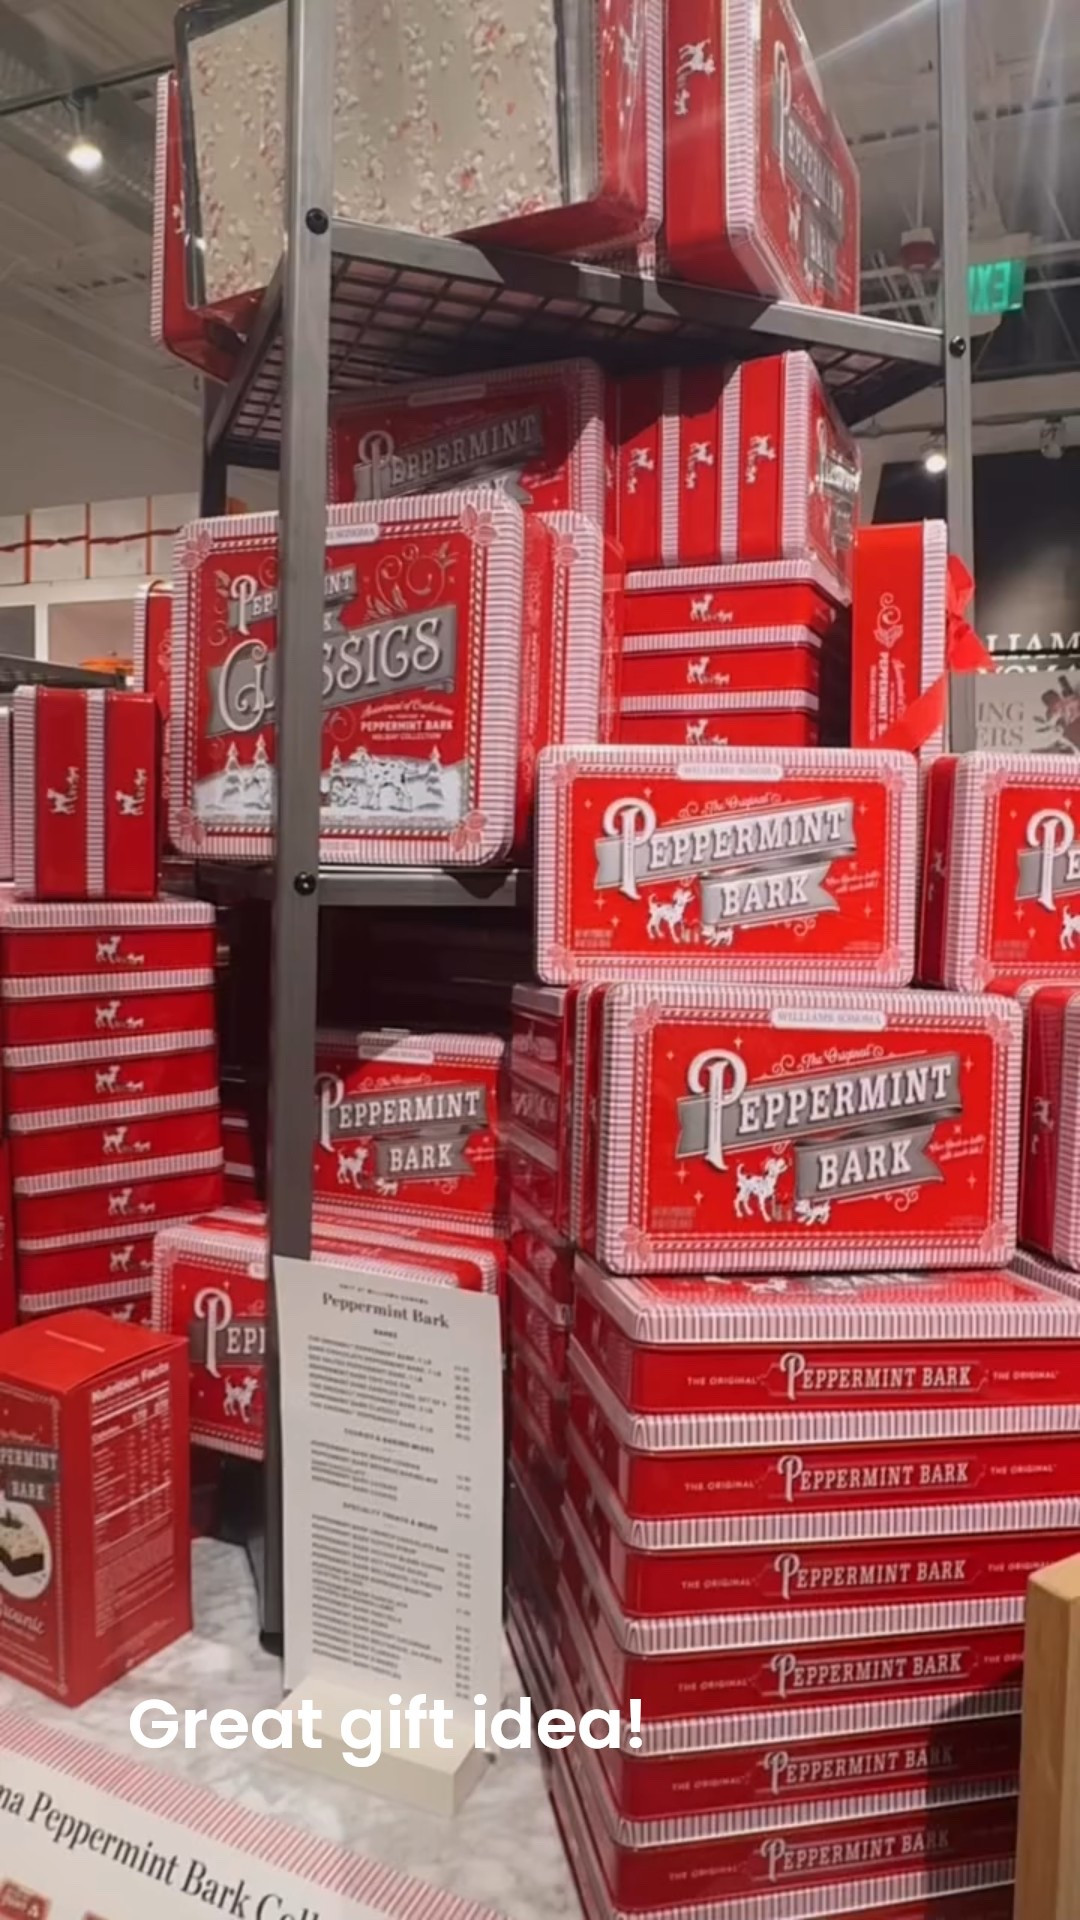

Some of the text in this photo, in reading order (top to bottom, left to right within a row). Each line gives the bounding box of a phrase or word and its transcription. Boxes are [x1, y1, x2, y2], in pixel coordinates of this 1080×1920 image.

[358, 414, 536, 500] PEPPERMINT
[361, 719, 453, 732] PEPPERMINT BARK
[603, 797, 846, 901] PEPPERMINT
[722, 873, 809, 918] BARK
[315, 1072, 480, 1153] PEPPERMINT
[687, 1048, 951, 1171] PEPPERMINT
[389, 1142, 453, 1172] BARK
[817, 1138, 913, 1191] BARK
[322, 1292, 408, 1321] Peppermint
[412, 1309, 450, 1328] Bark
[780, 1352, 915, 1400] PEPPERMINT
[922, 1366, 972, 1387] BARK
[11, 1480, 45, 1501] BARK
[777, 1454, 913, 1501] PEPPERMINT
[919, 1463, 968, 1485] BARK
[774, 1553, 911, 1600] PEPPERMINT
[917, 1559, 966, 1581] BARK
[771, 1653, 907, 1699] PEPPERMINT
[912, 1653, 962, 1675] BARK
[764, 1751, 898, 1794] PEPPERMINT
[905, 1748, 952, 1769] BARK
[28, 1791, 180, 1885] Peppermint
[180, 1858, 251, 1919] Bark
[761, 1837, 895, 1882] PEPPERMINT
[902, 1829, 949, 1852] BARK
